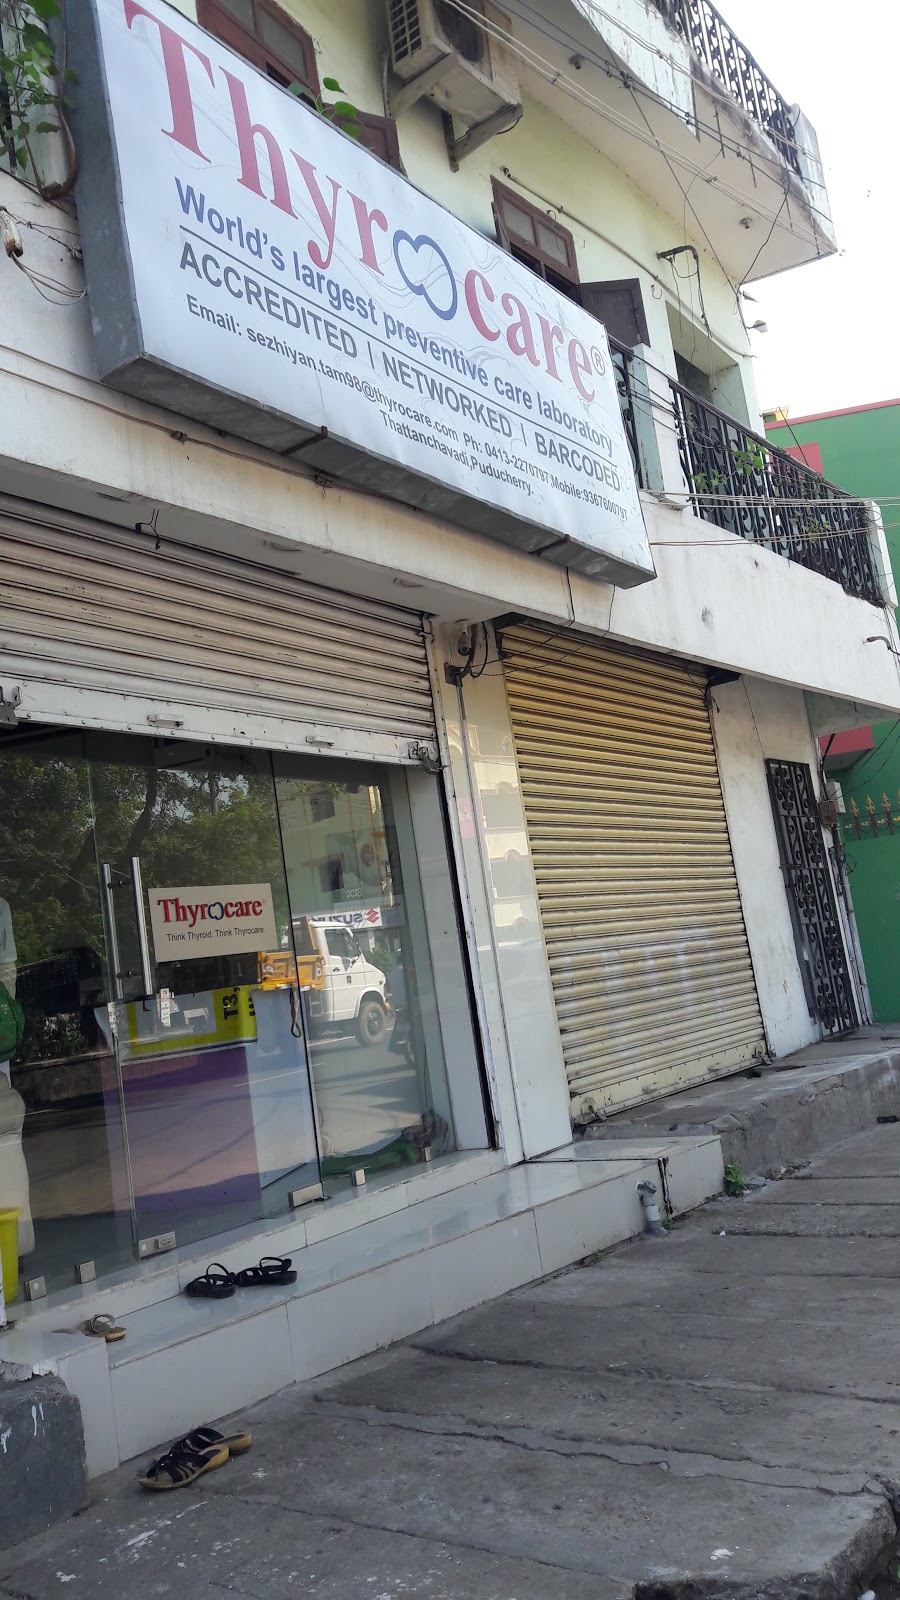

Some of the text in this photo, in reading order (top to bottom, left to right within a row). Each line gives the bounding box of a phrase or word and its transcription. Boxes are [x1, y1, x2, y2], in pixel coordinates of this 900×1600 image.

[175, 176, 613, 459] World's largest preventive care laboratory
[180, 241, 622, 493] ACCREDITED NETWORKED BARCODED
[186, 294, 243, 337] Email:
[246, 326, 460, 443] sezhiyan.tam98@thyrocare.com
[462, 431, 484, 454] Ph:
[157, 898, 264, 928] Thyrocare
[166, 926, 265, 942] Think Thyroid. Think Thyrocare.
